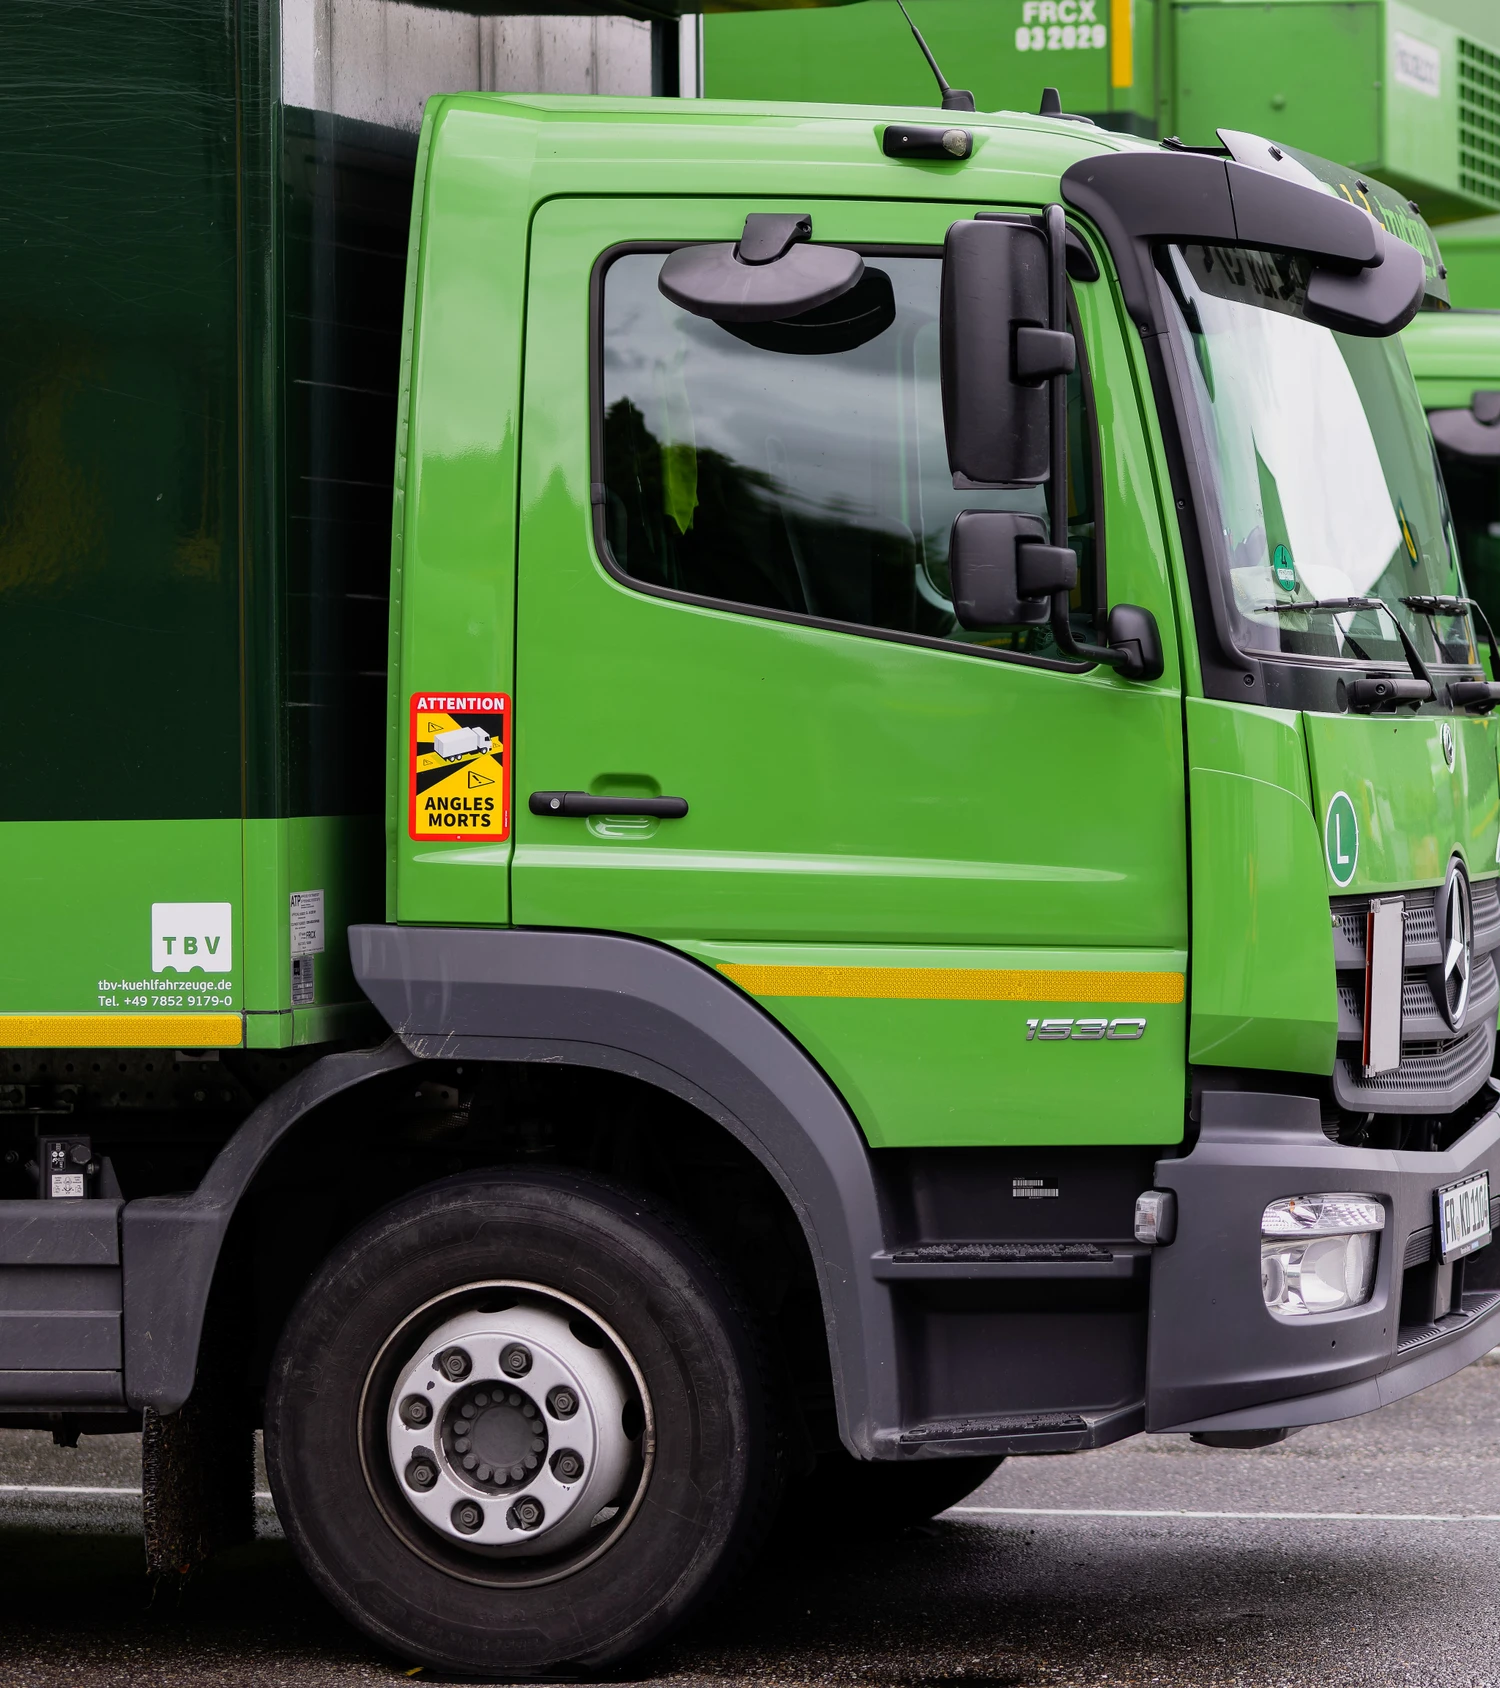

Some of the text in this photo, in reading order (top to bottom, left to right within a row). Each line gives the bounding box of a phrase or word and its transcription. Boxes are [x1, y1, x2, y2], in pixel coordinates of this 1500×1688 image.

[1022, 0, 1097, 23] FRCX
[417, 697, 505, 710] ATTENTION
[424, 796, 495, 811] ANGLES
[428, 813, 491, 827] MORTS
[1335, 813, 1350, 865] L
[97, 978, 233, 993] tbv-kuehlfahrzeuge.de
[97, 995, 233, 1007] Tel. +49 7852 9179-0
[1025, 1018, 1148, 1041] 1530
[1444, 1198, 1457, 1244] FR
